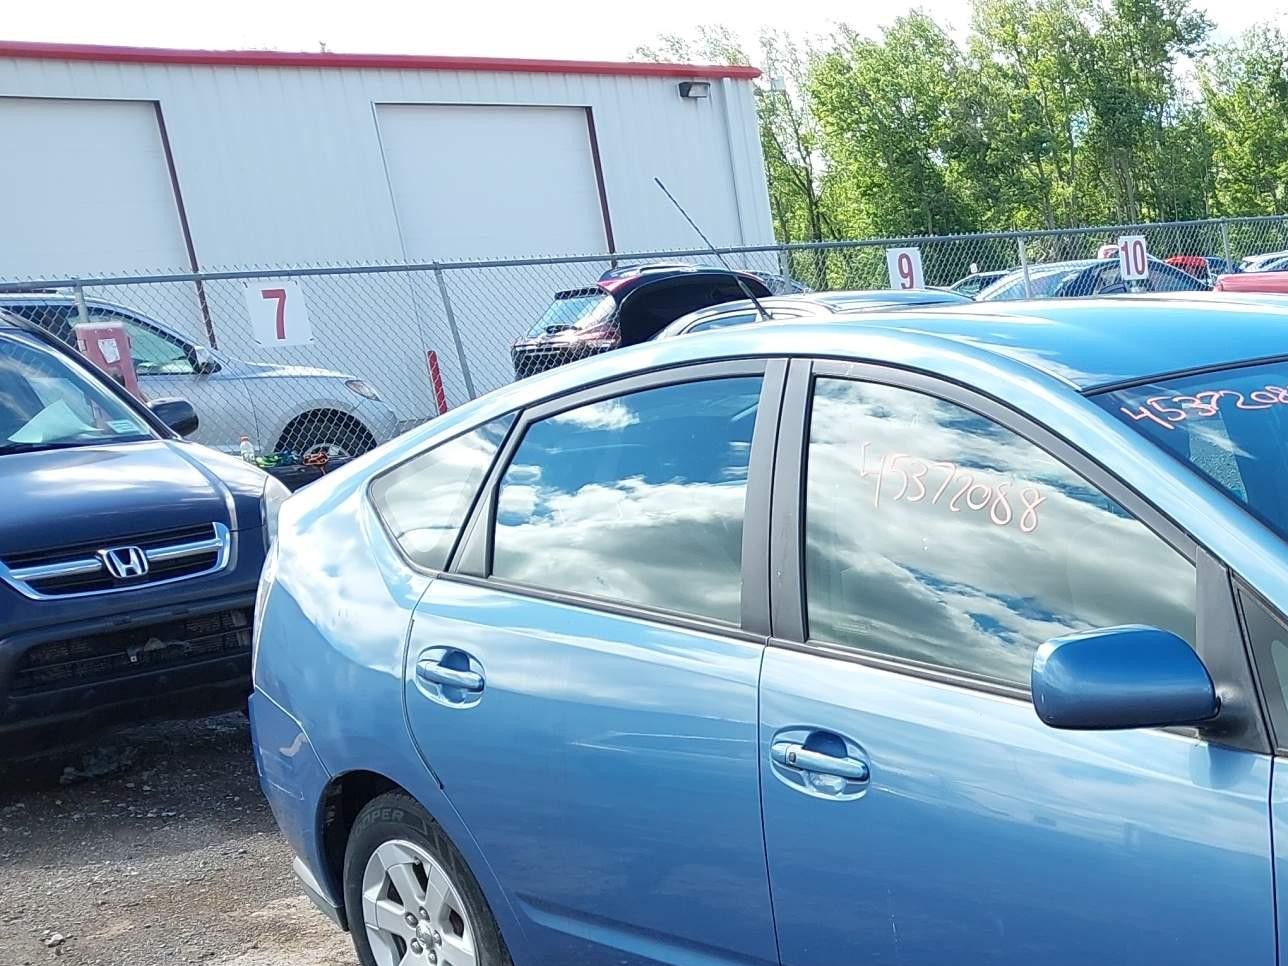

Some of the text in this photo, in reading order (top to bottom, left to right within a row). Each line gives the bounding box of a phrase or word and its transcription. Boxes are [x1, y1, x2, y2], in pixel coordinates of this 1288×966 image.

[898, 253, 914, 290] 9
[1120, 240, 1145, 276] 10
[261, 288, 287, 340] 7
[860, 440, 1047, 533] 45372088
